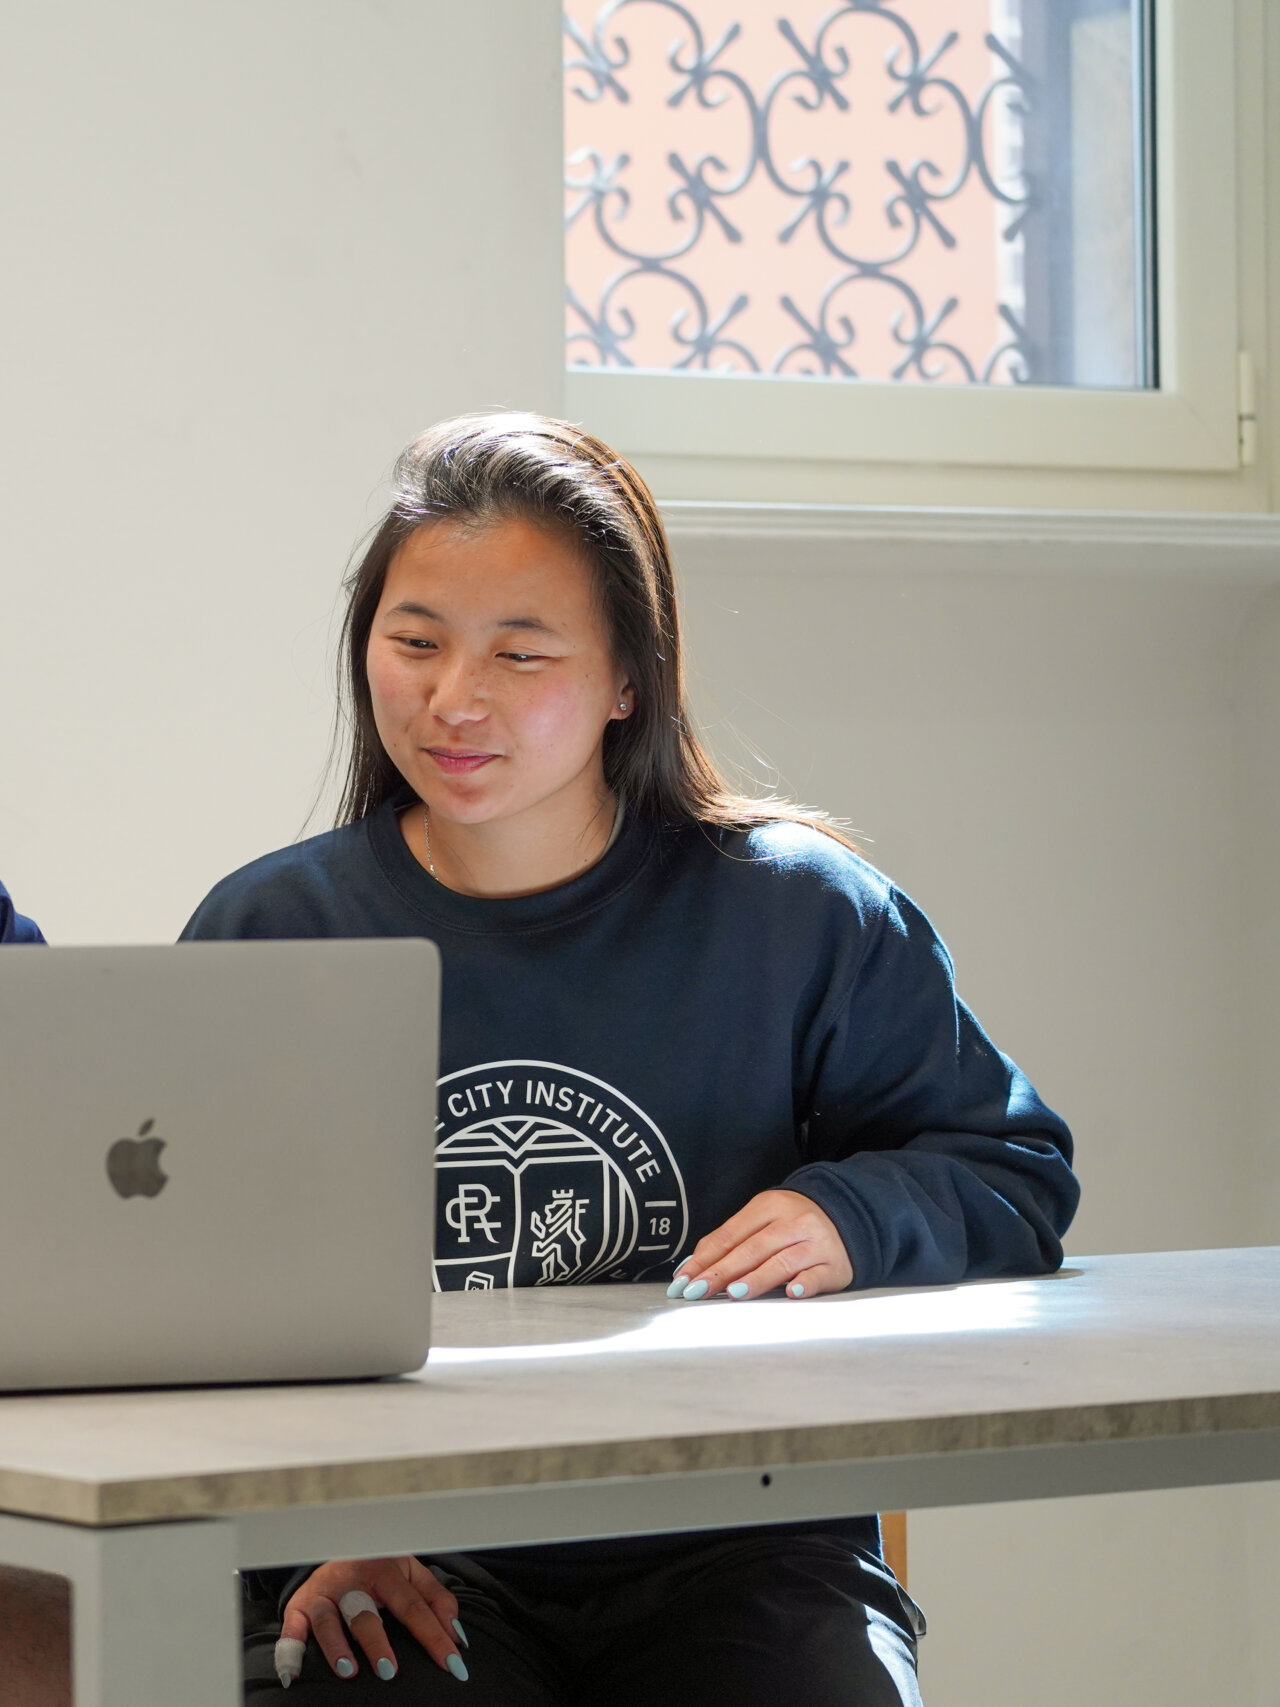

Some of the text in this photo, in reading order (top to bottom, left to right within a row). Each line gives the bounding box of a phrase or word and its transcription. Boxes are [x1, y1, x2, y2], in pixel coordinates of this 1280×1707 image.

[447, 1079, 661, 1183] CITY INSTITUTE
[649, 1217, 671, 1236] 18
